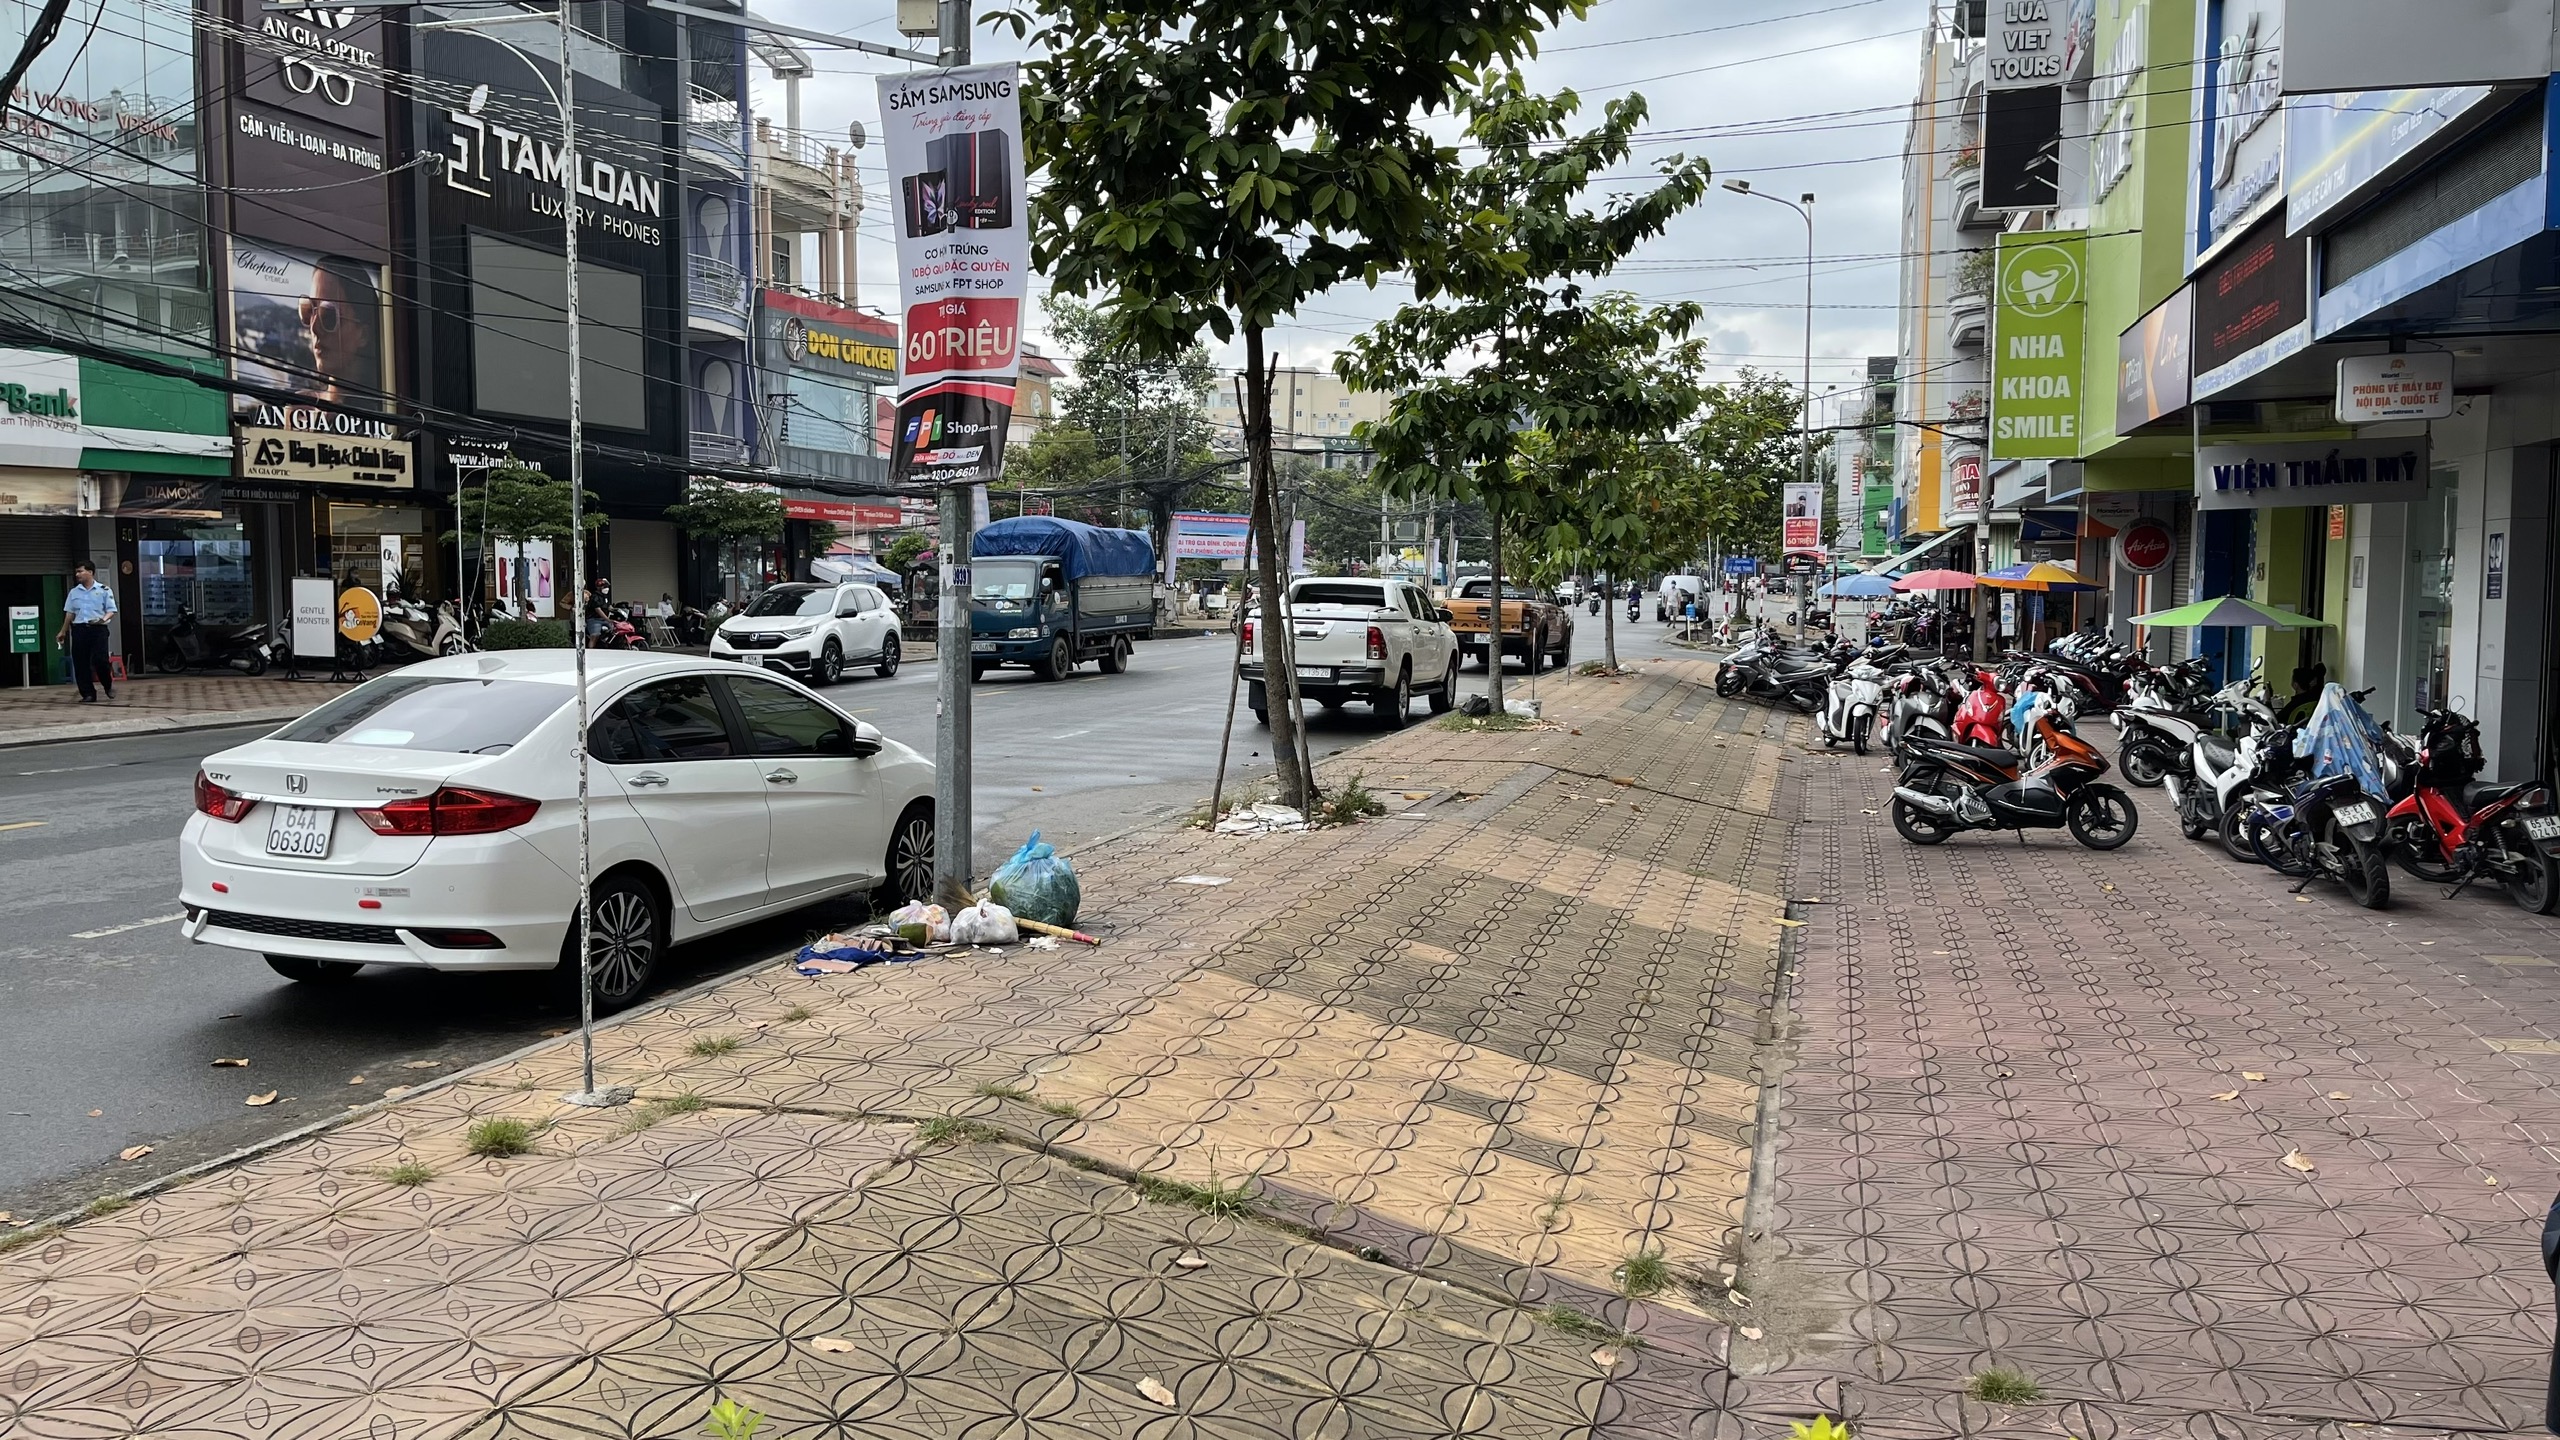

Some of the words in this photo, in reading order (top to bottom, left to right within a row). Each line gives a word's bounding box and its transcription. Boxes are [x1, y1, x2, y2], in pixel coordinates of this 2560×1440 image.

[2006, 0, 2048, 23] LUA
[262, 16, 288, 38] AN
[292, 27, 321, 50] GIA
[325, 38, 375, 67] OPTIC
[2003, 29, 2051, 52] VIET
[1991, 55, 2060, 80] TOURS
[929, 81, 1010, 104] SAMSUNG
[349, 147, 380, 170] TRÒNG
[531, 192, 595, 226] LUXRY
[604, 215, 660, 246] PHONES
[949, 242, 988, 255] TRÚNG
[234, 250, 290, 276] Chopard
[971, 257, 1009, 272] QUYỀN
[953, 278, 972, 289] FPT
[975, 278, 1003, 290] SHOP
[946, 301, 966, 315] GIÁ
[808, 330, 838, 359] DON
[841, 338, 896, 371] CHICKEN
[908, 331, 935, 362] 60
[938, 319, 1013, 366] TRIỆU
[2009, 334, 2064, 359] NHA
[2002, 375, 2071, 400] KHOA
[2353, 382, 2385, 395] PHÒNG
[2388, 382, 2398, 393] VÉ
[2402, 381, 2422, 392] MÁY
[2425, 381, 2443, 391] BAY
[2356, 396, 2372, 409] NỘI
[2375, 396, 2391, 409] ĐỊA
[2401, 393, 2425, 406] QUỐC
[2428, 391, 2440, 404] TẾ
[17, 416, 43, 428] Thịnh
[257, 404, 286, 427] AN
[292, 408, 329, 432] GIA
[905, 415, 942, 442] FPT
[1997, 414, 2075, 439] SMILE
[342, 448, 353, 466] &
[932, 468, 954, 480] 1800
[955, 466, 980, 478] 6601
[2213, 457, 2276, 496] VIỆN
[145, 485, 204, 500] DIAMOND
[297, 617, 330, 625] MONSTER
[300, 606, 325, 614] GENTLE
[210, 772, 232, 781] CITY
[287, 809, 317, 830] 64A
[270, 828, 326, 854] 063.09
